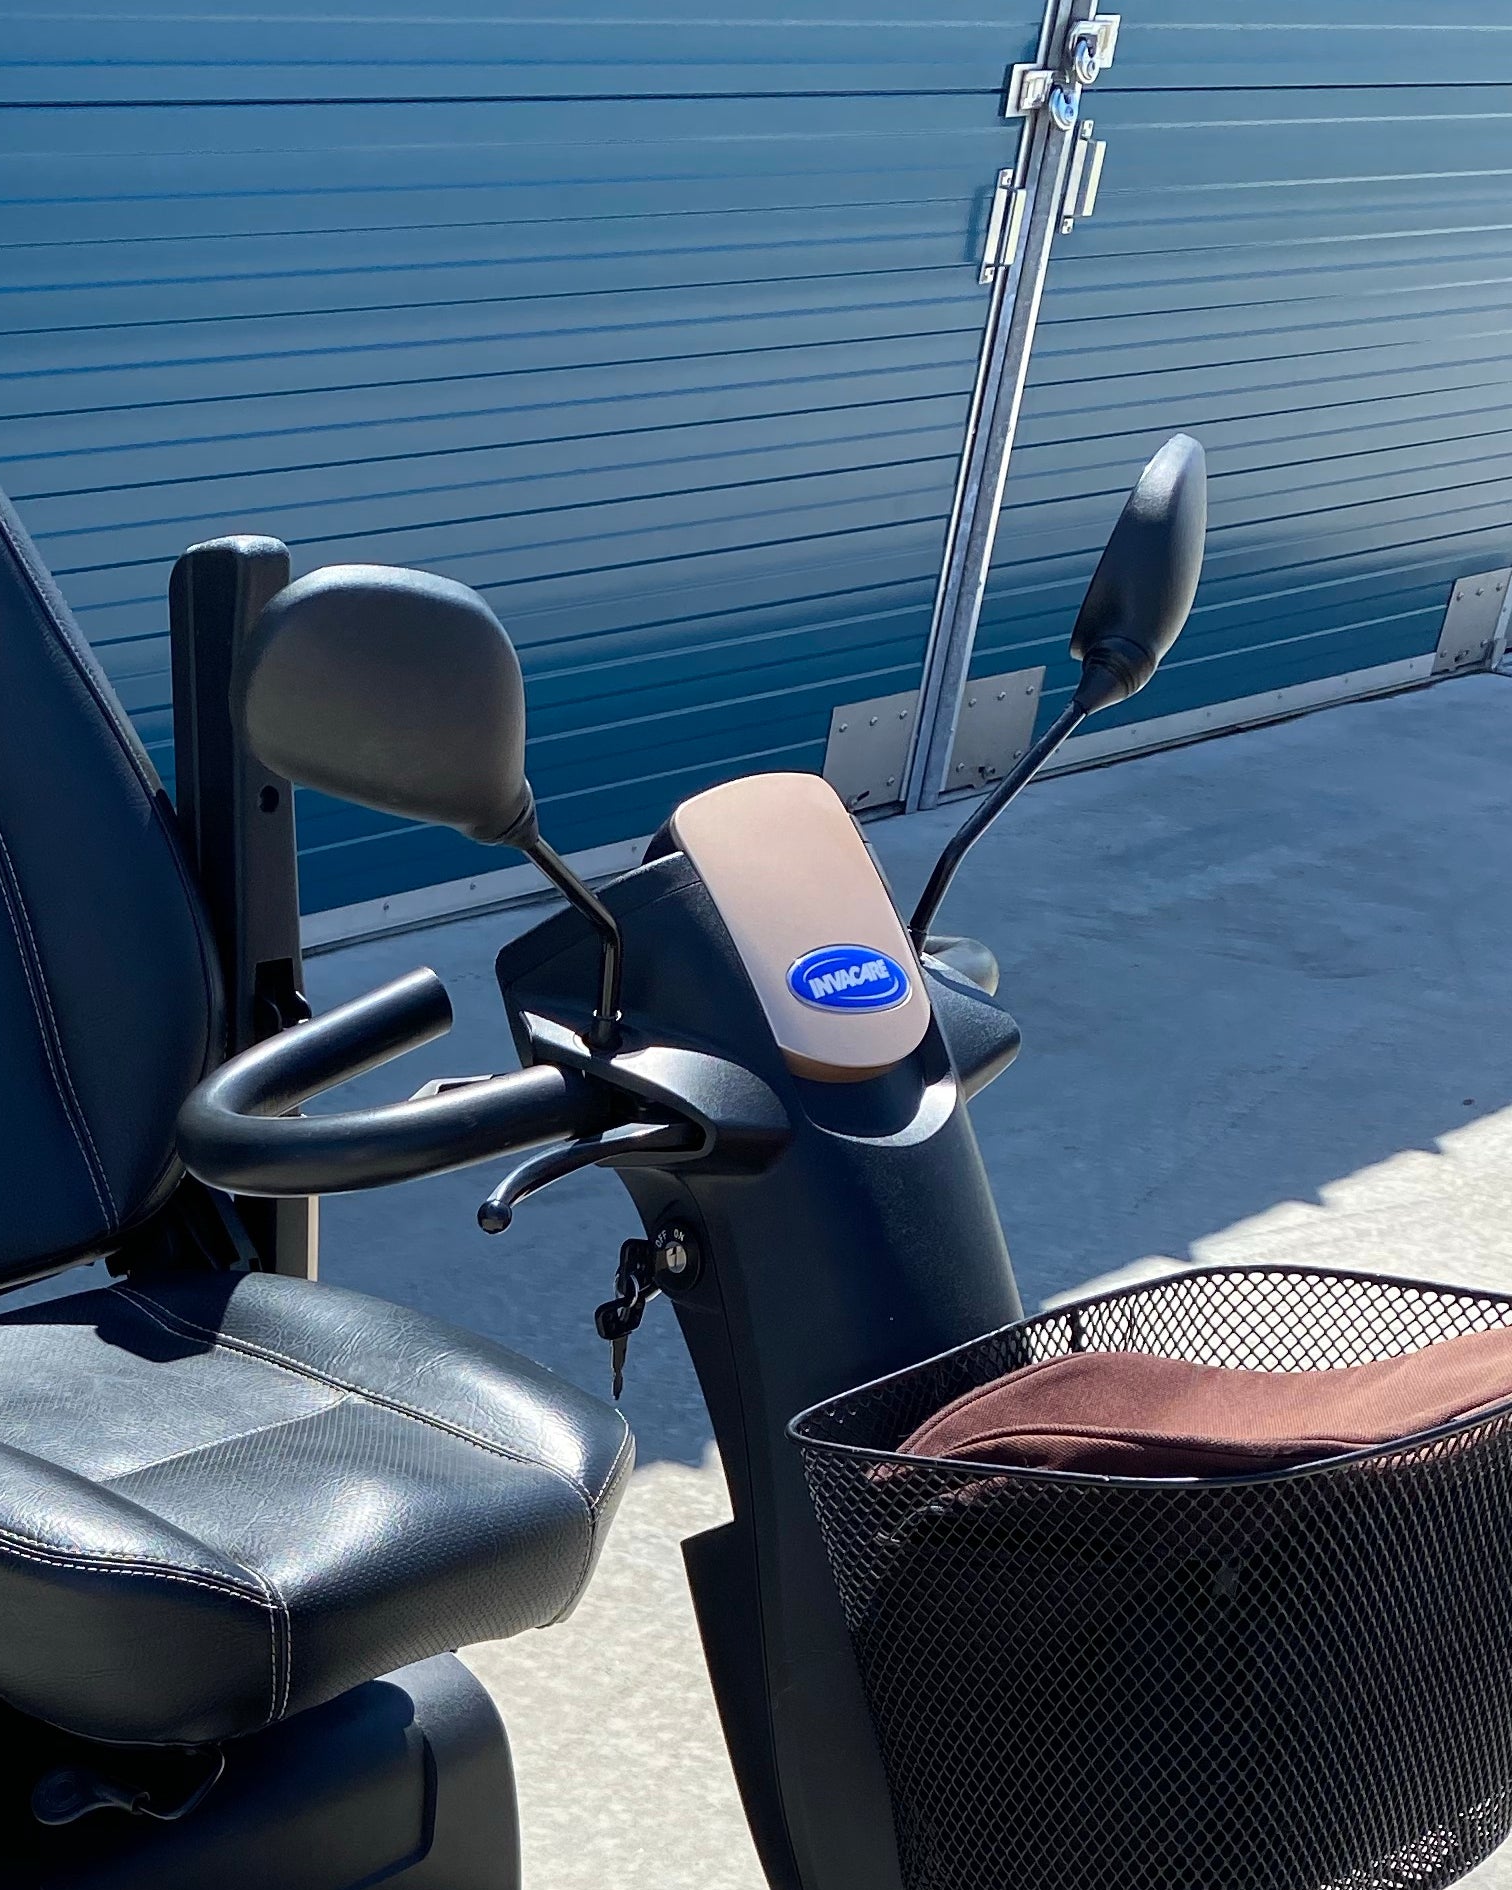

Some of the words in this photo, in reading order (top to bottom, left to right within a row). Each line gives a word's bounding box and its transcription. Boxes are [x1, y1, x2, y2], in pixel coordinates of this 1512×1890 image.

[808, 958, 890, 1000] INVACARE
[655, 1229, 667, 1247] OFF
[673, 1228, 685, 1241] ON
